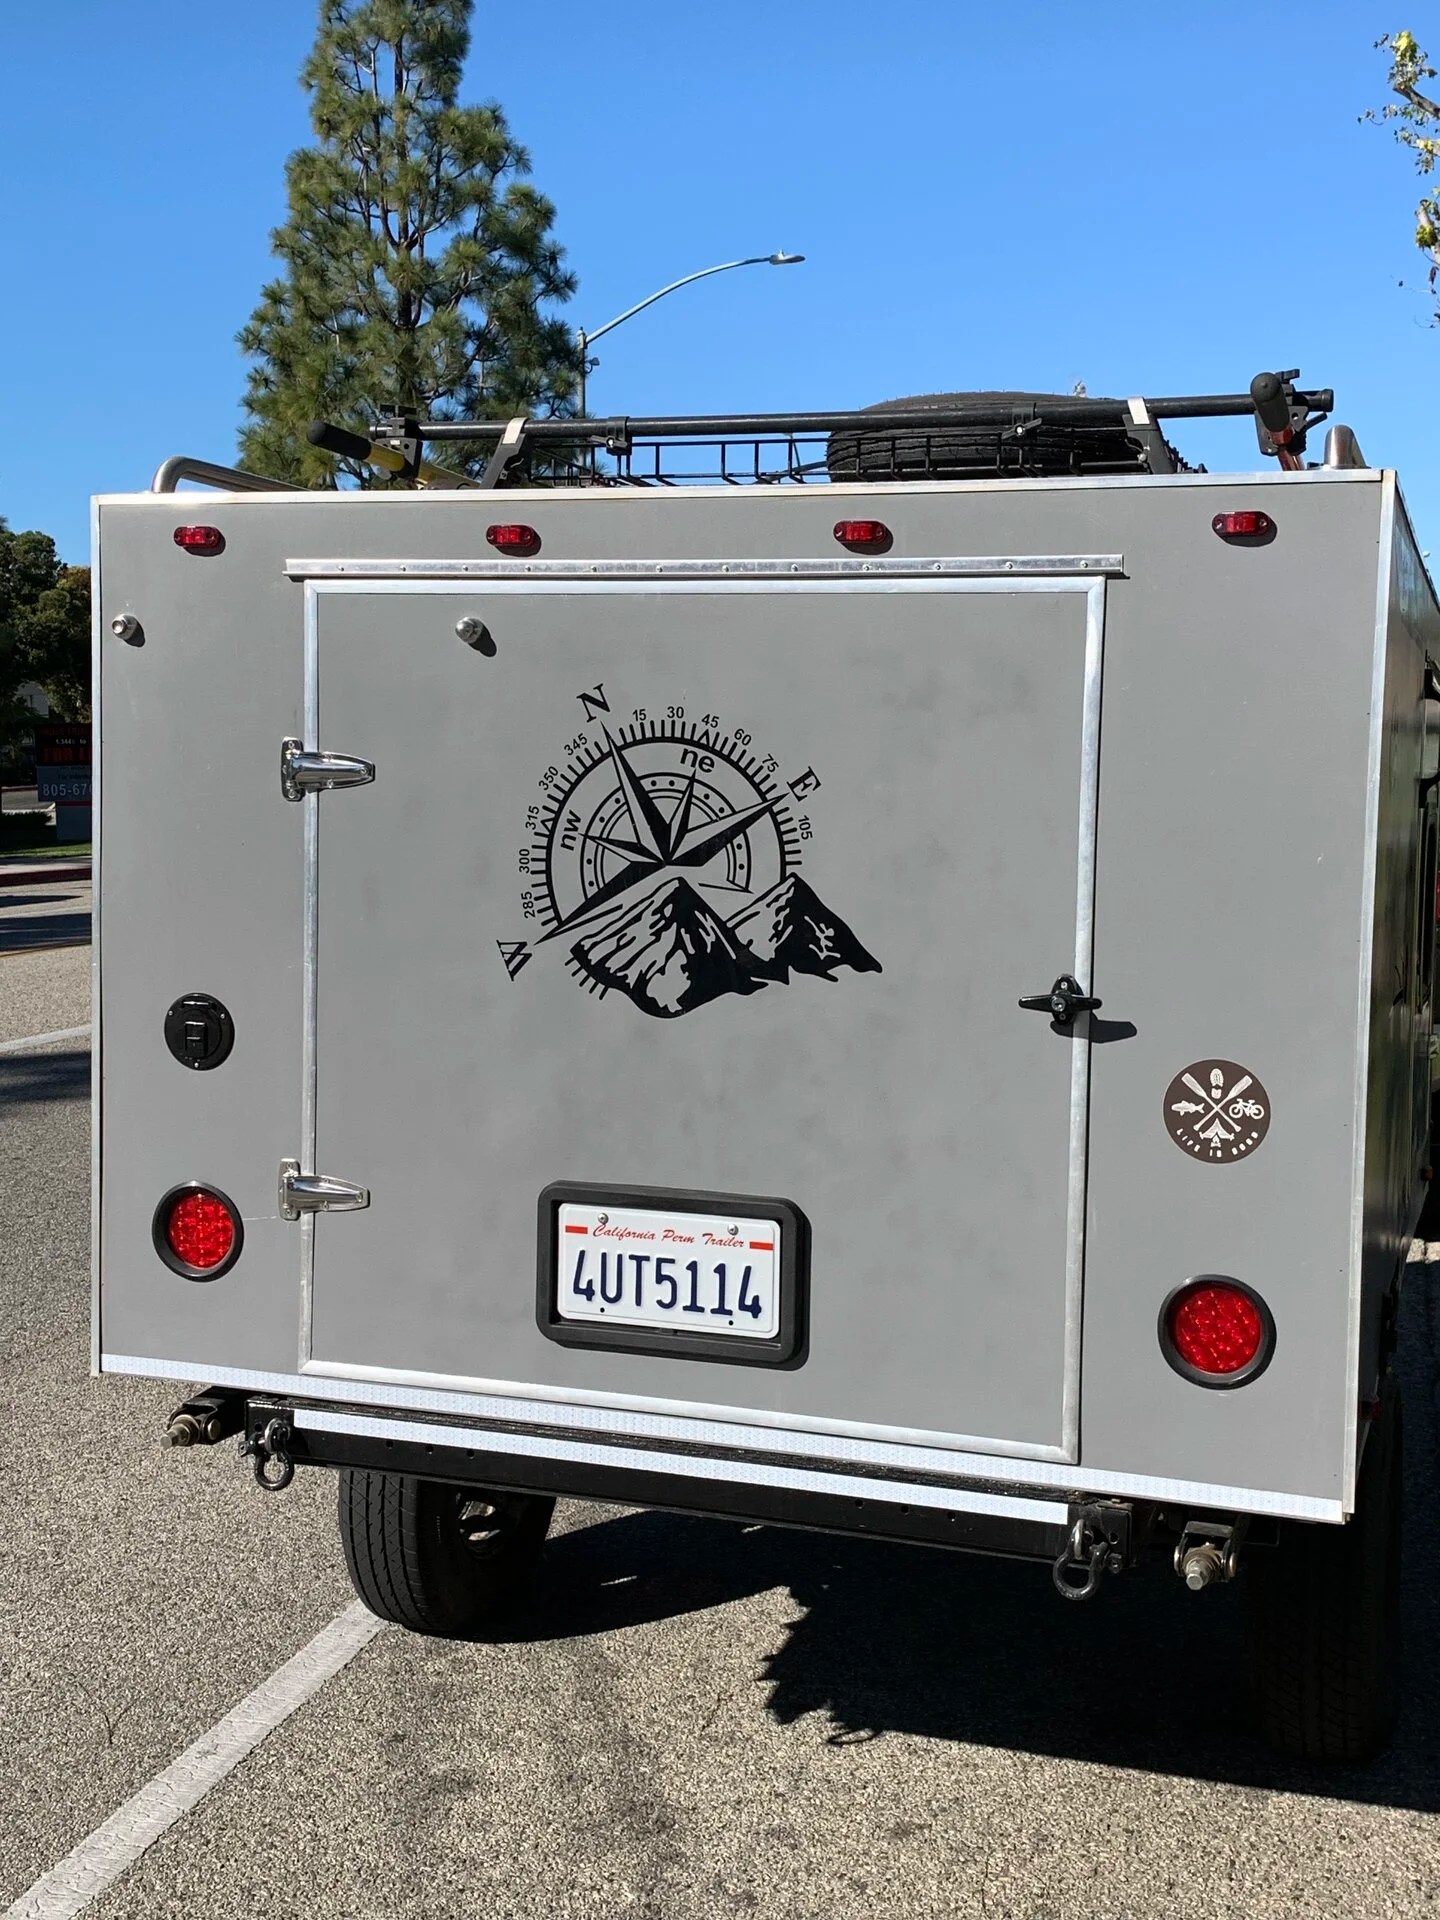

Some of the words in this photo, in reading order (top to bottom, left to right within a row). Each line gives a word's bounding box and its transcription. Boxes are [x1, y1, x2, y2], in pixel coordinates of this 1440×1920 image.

[576, 683, 611, 723] N
[631, 708, 648, 722] 15
[666, 706, 685, 720] 30
[701, 713, 720, 729] 45
[563, 732, 589, 757] 345
[733, 727, 753, 747] 60
[679, 746, 716, 773] ne
[762, 753, 780, 774] 75
[538, 765, 560, 792] 350
[786, 766, 822, 802] E
[525, 805, 541, 831] 315
[560, 809, 582, 851] nw
[797, 814, 814, 841] 105
[518, 847, 531, 874] 300
[523, 890, 537, 919] 285
[496, 939, 533, 982] W
[592, 1224, 657, 1241] California
[661, 1229, 695, 1244] Perm
[702, 1232, 745, 1249] Trailer
[572, 1249, 763, 1319] 4UT5114
